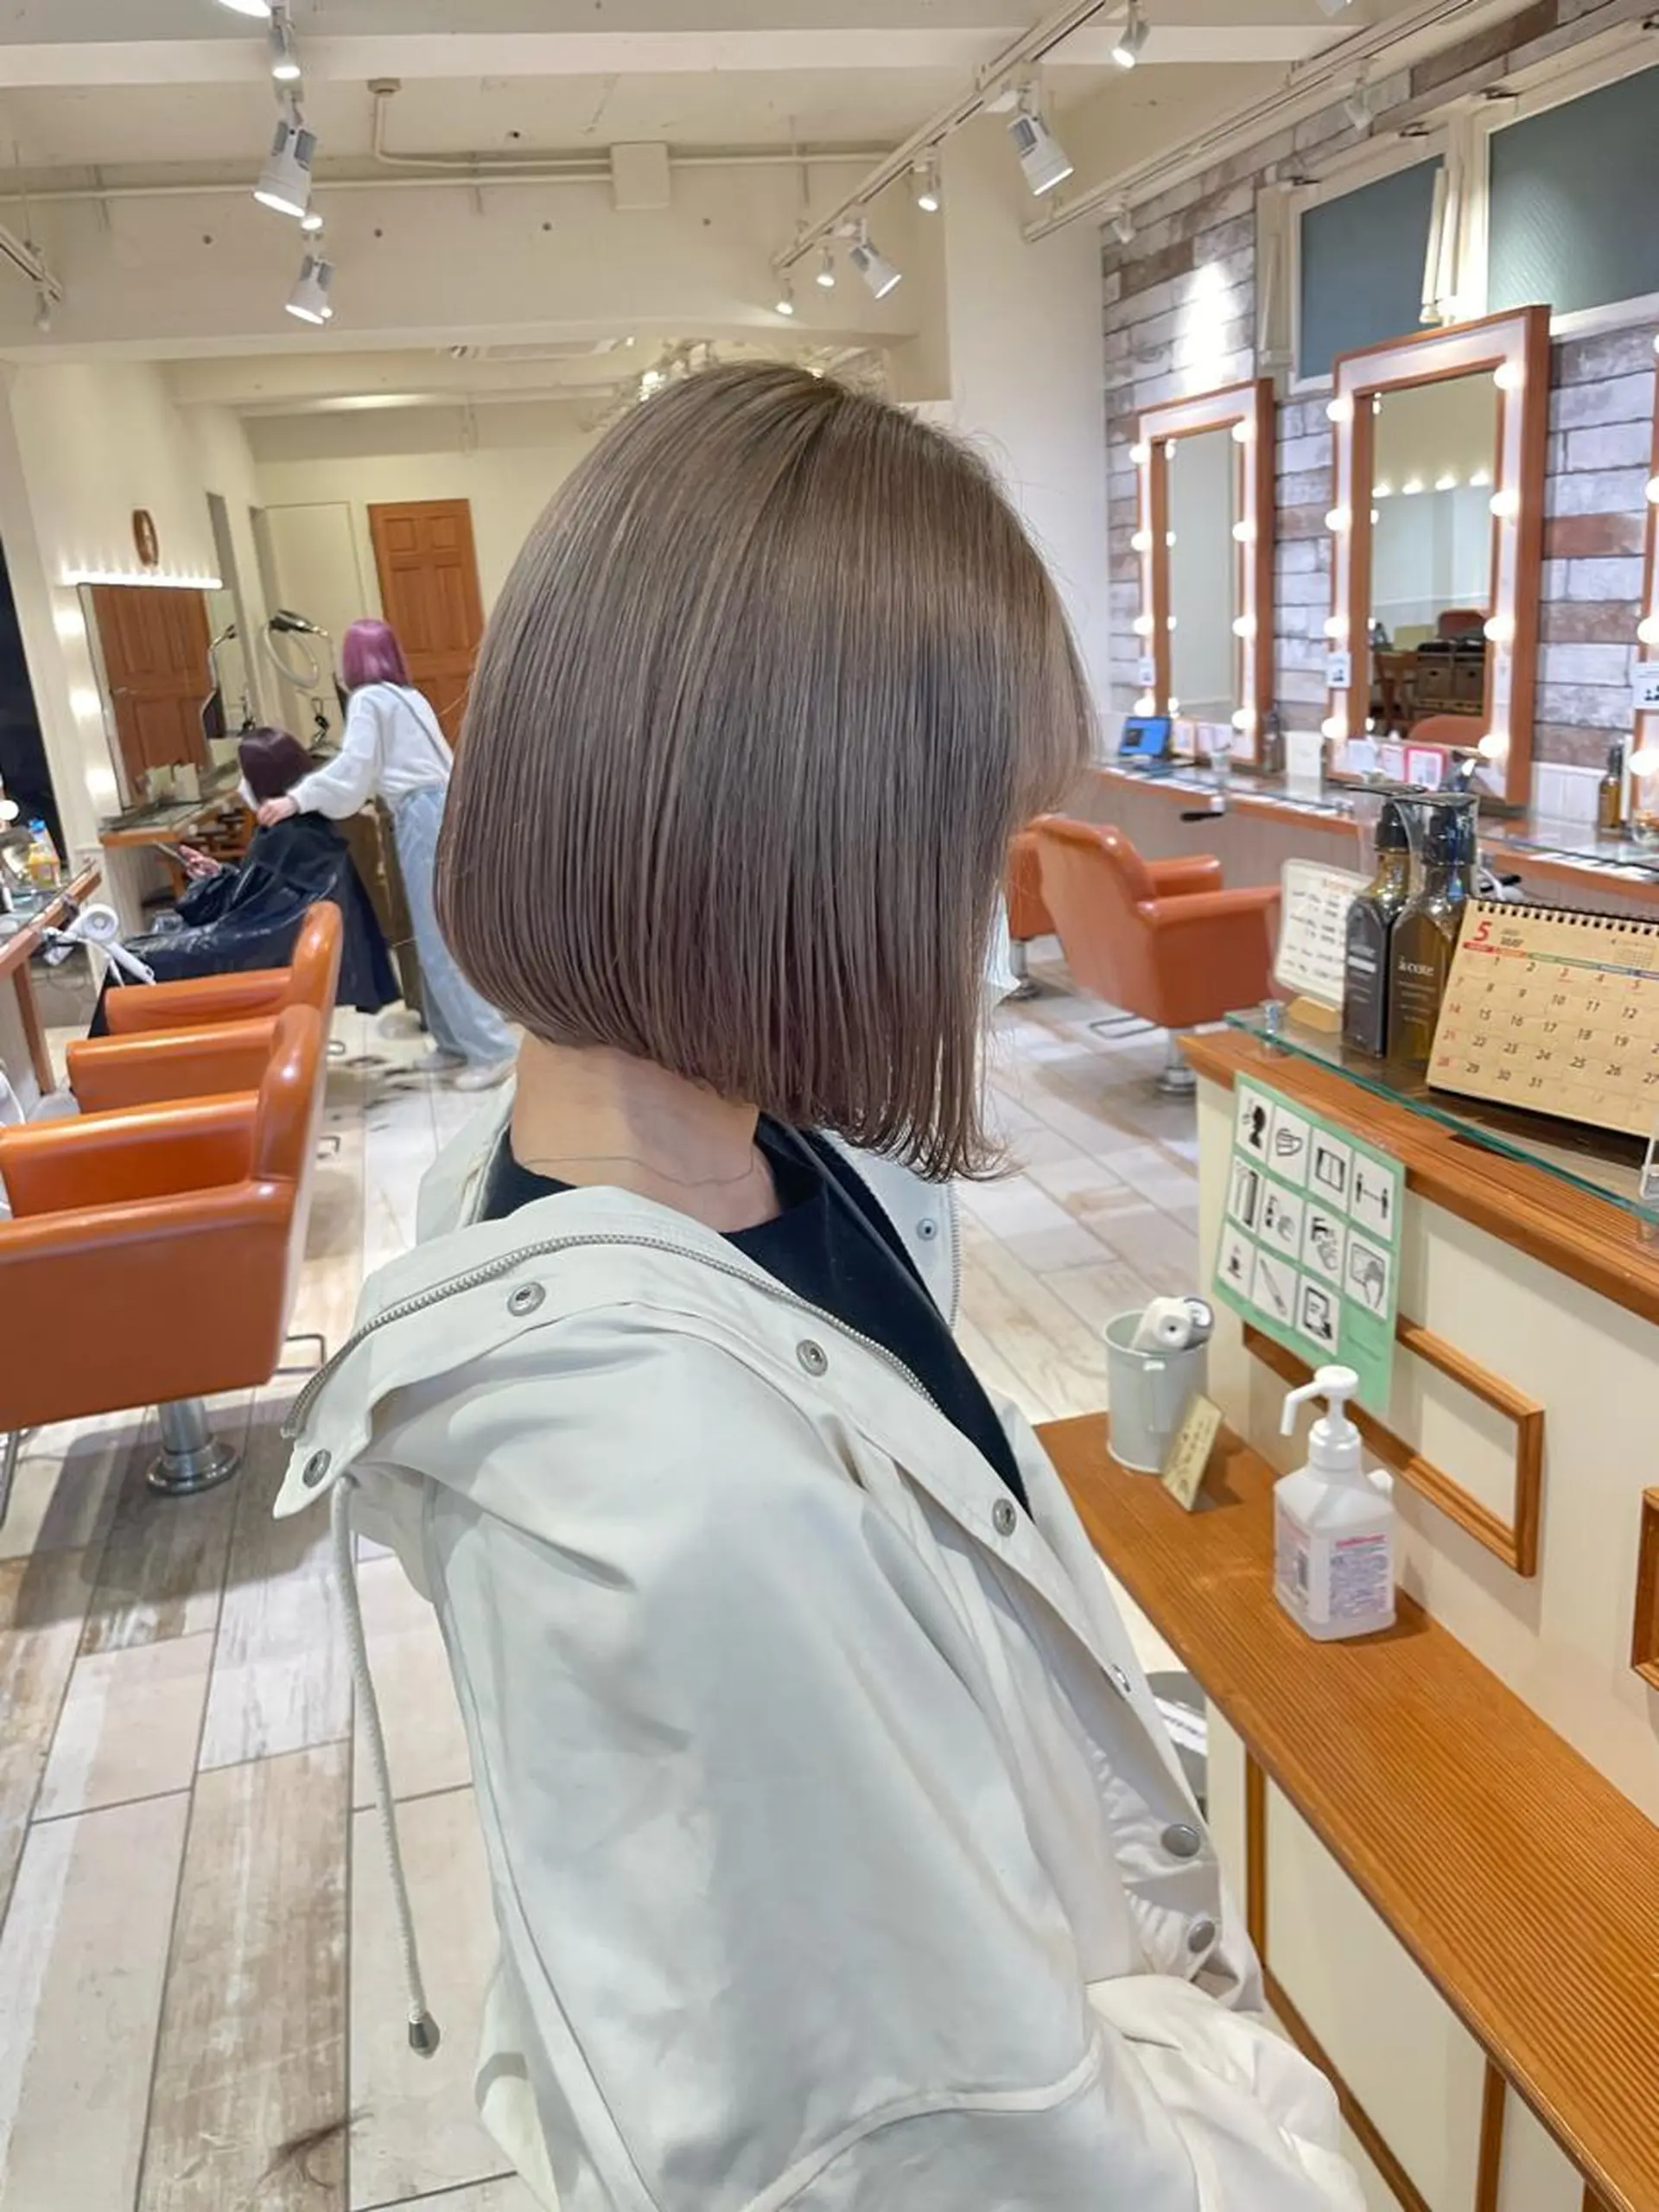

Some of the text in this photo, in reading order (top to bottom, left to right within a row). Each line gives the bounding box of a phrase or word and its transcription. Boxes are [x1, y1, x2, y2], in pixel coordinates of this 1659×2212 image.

[1473, 920, 1493, 942] 5
[1526, 961, 1536, 972] 2
[1552, 994, 1567, 1006] 10
[1586, 1000, 1600, 1013] 11
[1622, 1006, 1638, 1020] 12
[1510, 1014, 1523, 1027] 16
[1542, 1020, 1557, 1033] 17
[1578, 1027, 1593, 1040] 18
[1614, 1034, 1630, 1047] 19
[1503, 1042, 1518, 1054] 23
[1535, 1048, 1552, 1061] 24
[1570, 1055, 1587, 1069] 25
[1605, 1064, 1622, 1077] 26
